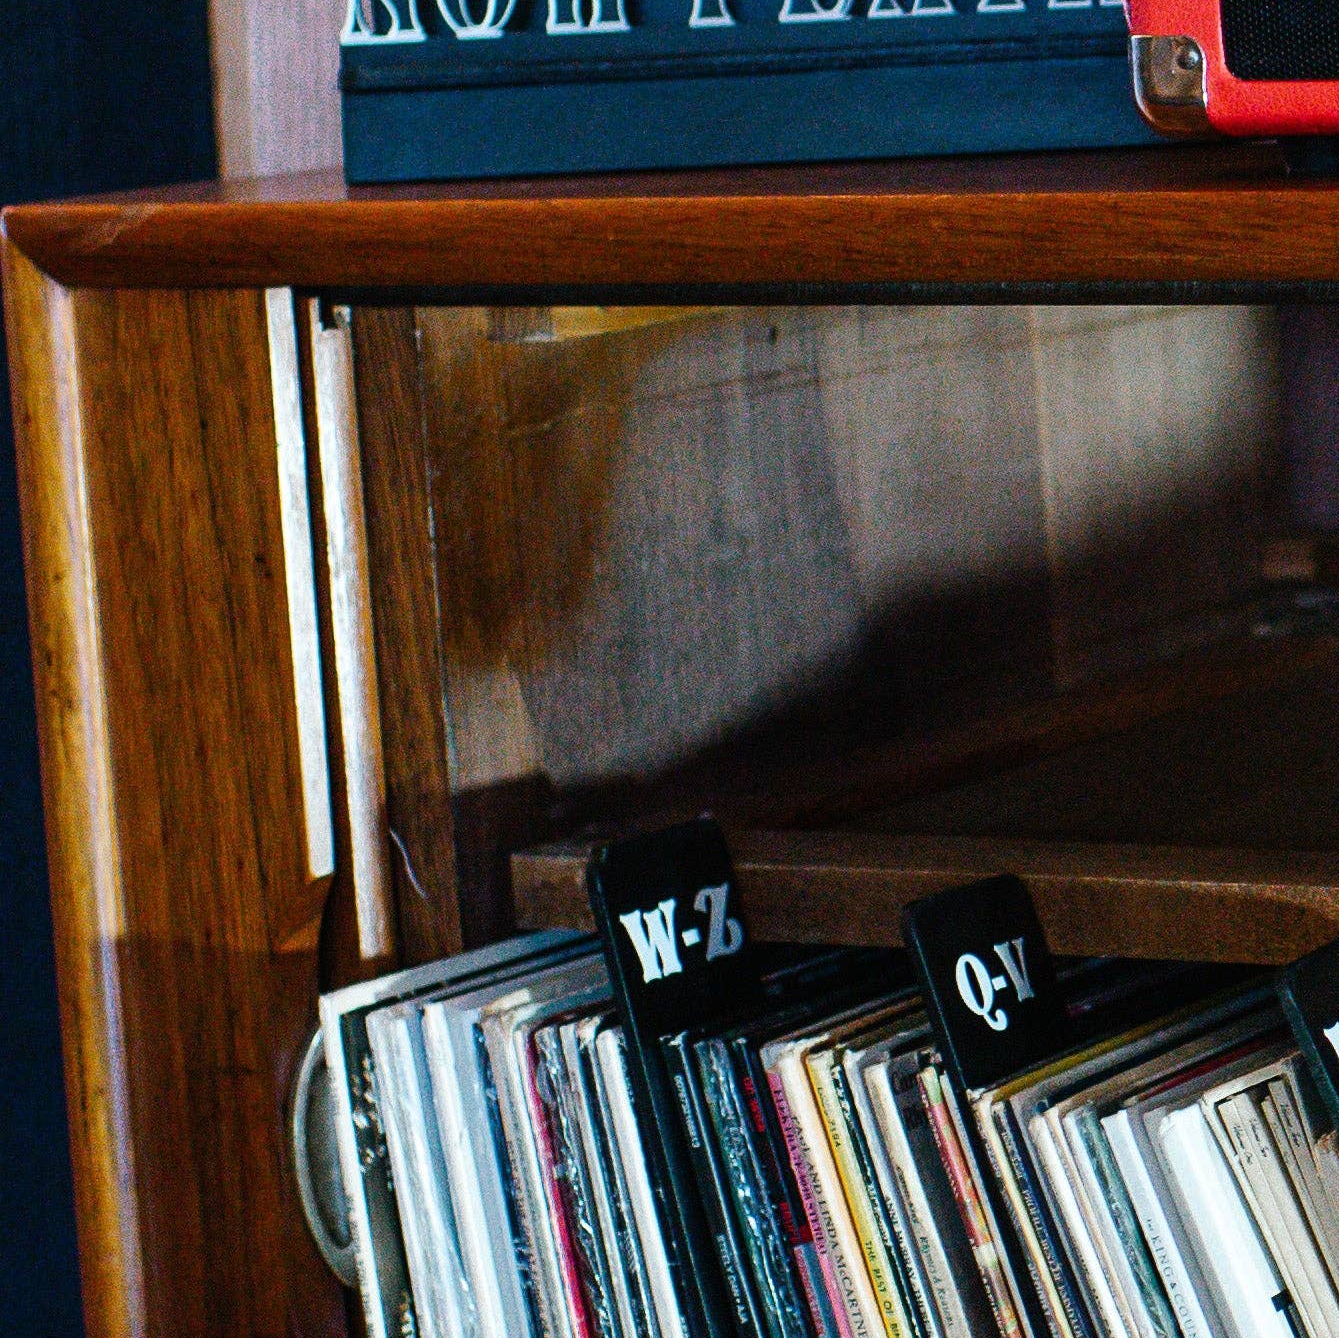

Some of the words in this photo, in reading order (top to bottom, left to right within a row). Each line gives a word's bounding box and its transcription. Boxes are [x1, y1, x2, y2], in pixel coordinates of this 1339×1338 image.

[618, 881, 744, 985] W-Z
[954, 935, 1035, 1032] Q-V
[805, 1161, 824, 1194] AND
[816, 1199, 840, 1249] LINDA
[863, 1240, 877, 1262] THE
[872, 1268, 887, 1293] BEST
[882, 1299, 895, 1318] OF
[1149, 1234, 1176, 1280] KING
